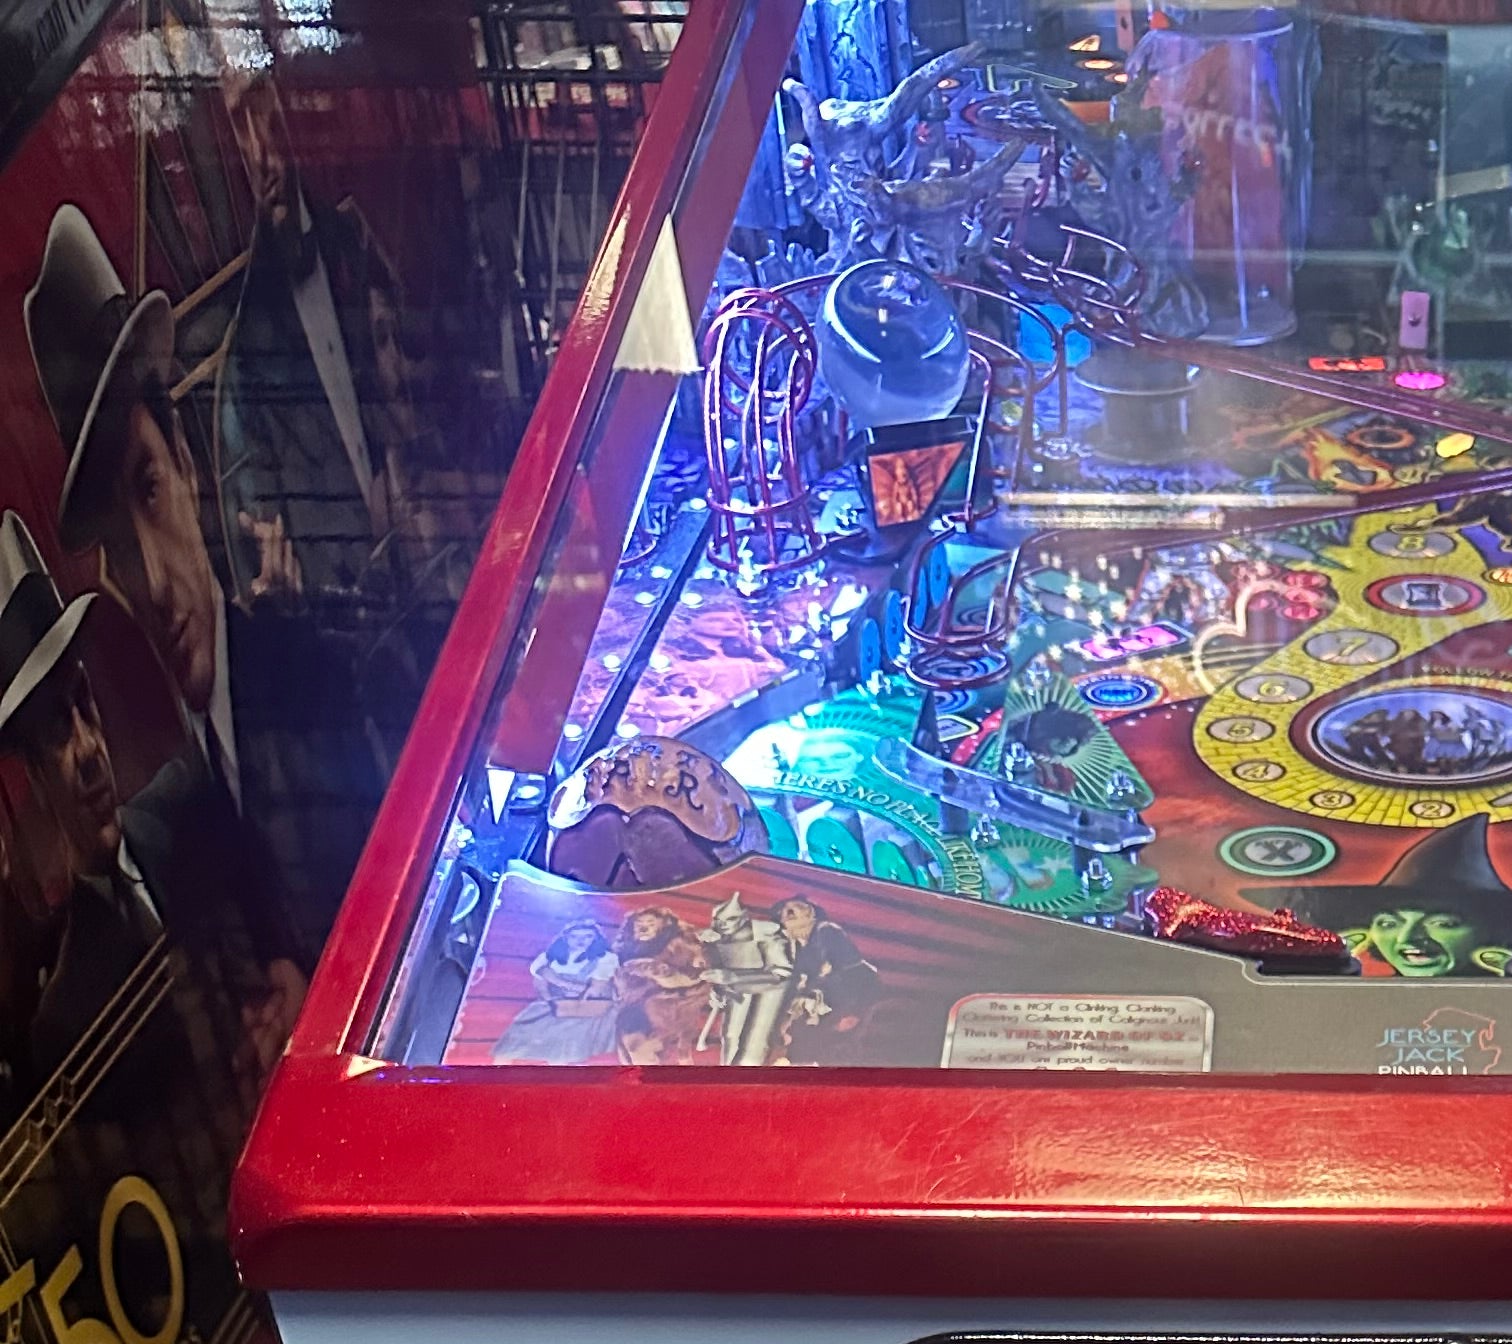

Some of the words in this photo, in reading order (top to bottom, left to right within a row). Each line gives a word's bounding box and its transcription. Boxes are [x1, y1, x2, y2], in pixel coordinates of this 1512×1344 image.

[1421, 802, 1443, 818] 2
[953, 861, 983, 900] HOM
[1376, 1028, 1476, 1048] JERSEY
[1391, 1047, 1465, 1066] JACK
